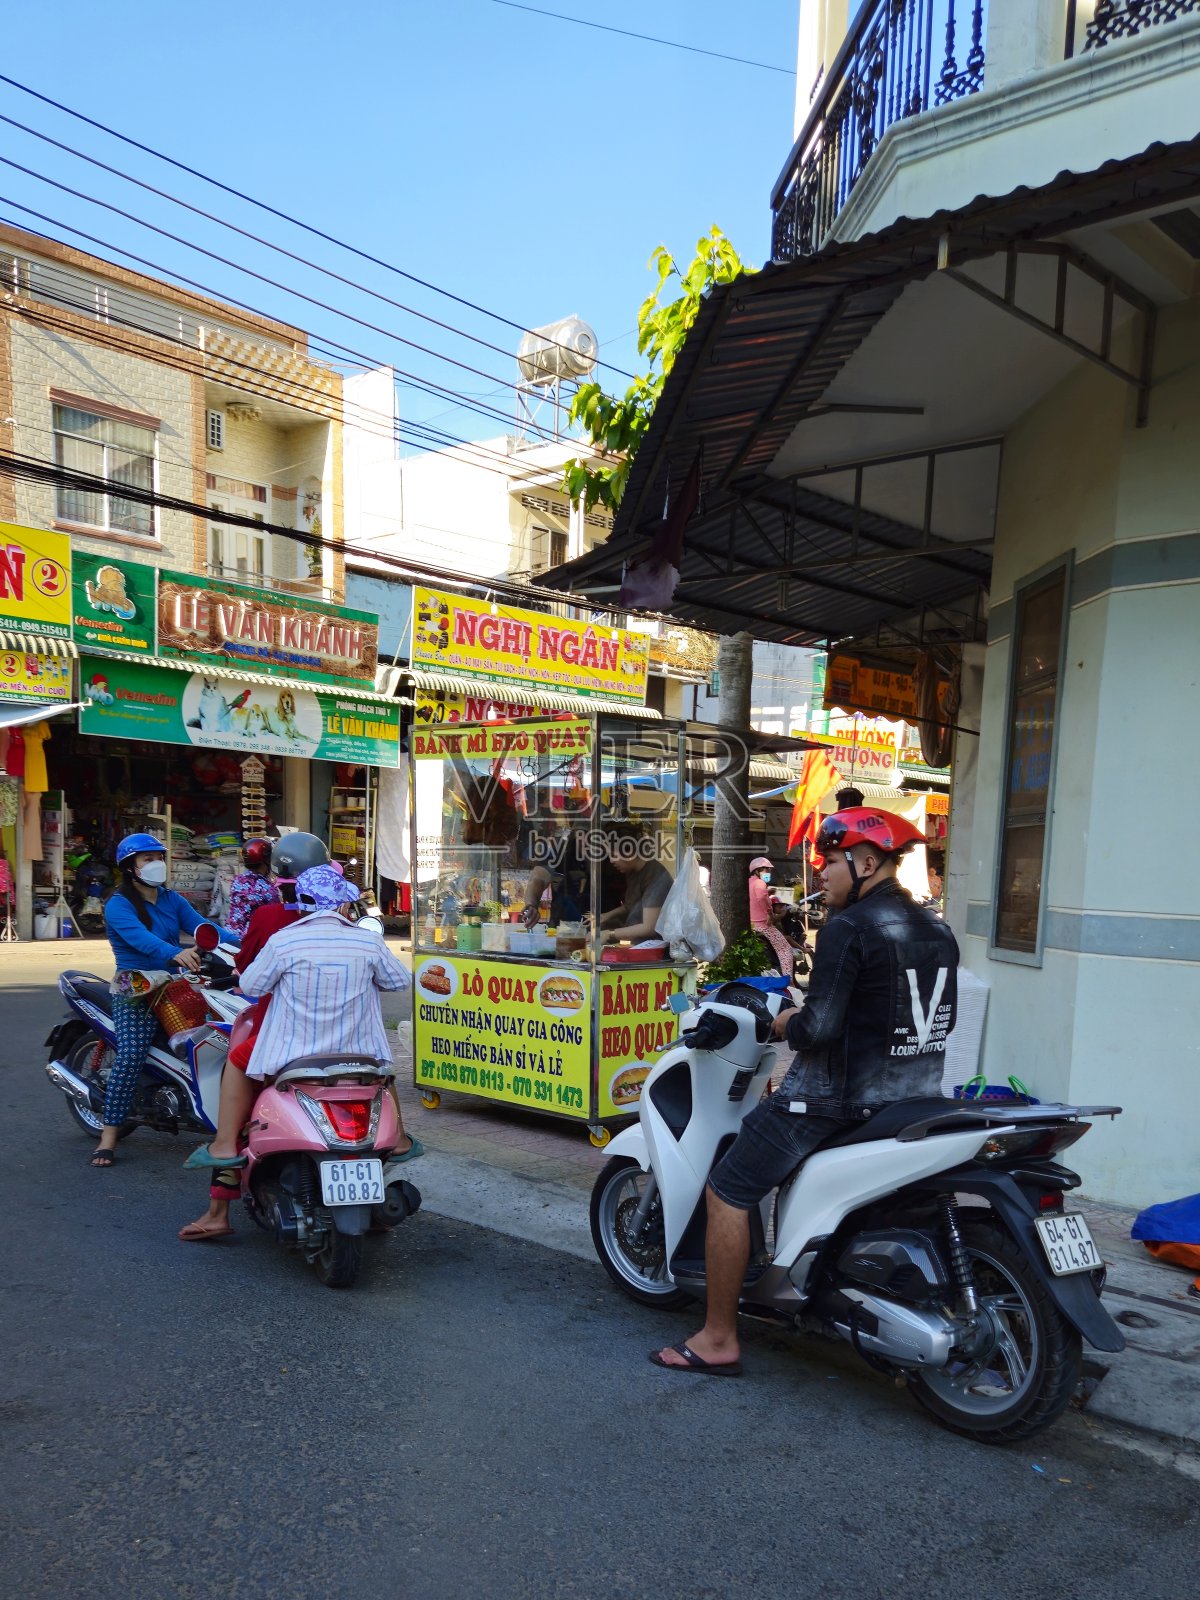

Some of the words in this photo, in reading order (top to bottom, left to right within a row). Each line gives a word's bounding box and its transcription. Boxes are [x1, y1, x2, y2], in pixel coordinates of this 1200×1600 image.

[41, 563, 58, 591] 2
[75, 615, 124, 633] Vemedim
[280, 616, 363, 660] KHÁNH
[453, 607, 532, 663] NGHỊ
[537, 625, 620, 671] NGÂN
[5, 656, 15, 673] 2
[116, 688, 178, 707] Vemedim
[327, 712, 340, 734] LÊ
[342, 714, 364, 736] VĂN
[365, 719, 399, 742] KHÁNH
[414, 729, 463, 755] BÁNH
[467, 728, 487, 753] MÌ
[491, 729, 528, 752] HEO
[532, 725, 591, 754] QUAY
[825, 744, 892, 768] PHƯỢNG
[462, 968, 484, 996] LÒ
[488, 976, 538, 1004] QUAY
[602, 975, 649, 1016] BÁNH
[654, 972, 673, 1011] MÌ
[420, 1003, 458, 1026] CHUYÊN
[461, 1007, 492, 1034] NHẬN
[495, 1015, 525, 1036] QUAY
[527, 1018, 548, 1041] GIA
[550, 1019, 583, 1045] CÔNG
[431, 1036, 451, 1055] HEO
[453, 1034, 487, 1063] MIẾNG
[490, 1043, 513, 1067] BÁN
[515, 1044, 526, 1069] SỈ
[529, 1050, 546, 1074] VÀ
[549, 1049, 563, 1076] LẺ
[602, 1025, 631, 1059] HEO
[634, 1021, 675, 1060] QUAY
[890, 1045, 917, 1056] LOUIS
[459, 1065, 478, 1087] 870
[480, 1068, 504, 1092] 8113
[513, 1075, 532, 1098] 070
[534, 1080, 553, 1102] 331
[556, 1084, 583, 1108] 1473
[330, 1162, 372, 1182] 61-G1
[327, 1182, 381, 1202] 108.82
[1044, 1216, 1083, 1243] 64-G1
[1050, 1240, 1096, 1271] 314.87
